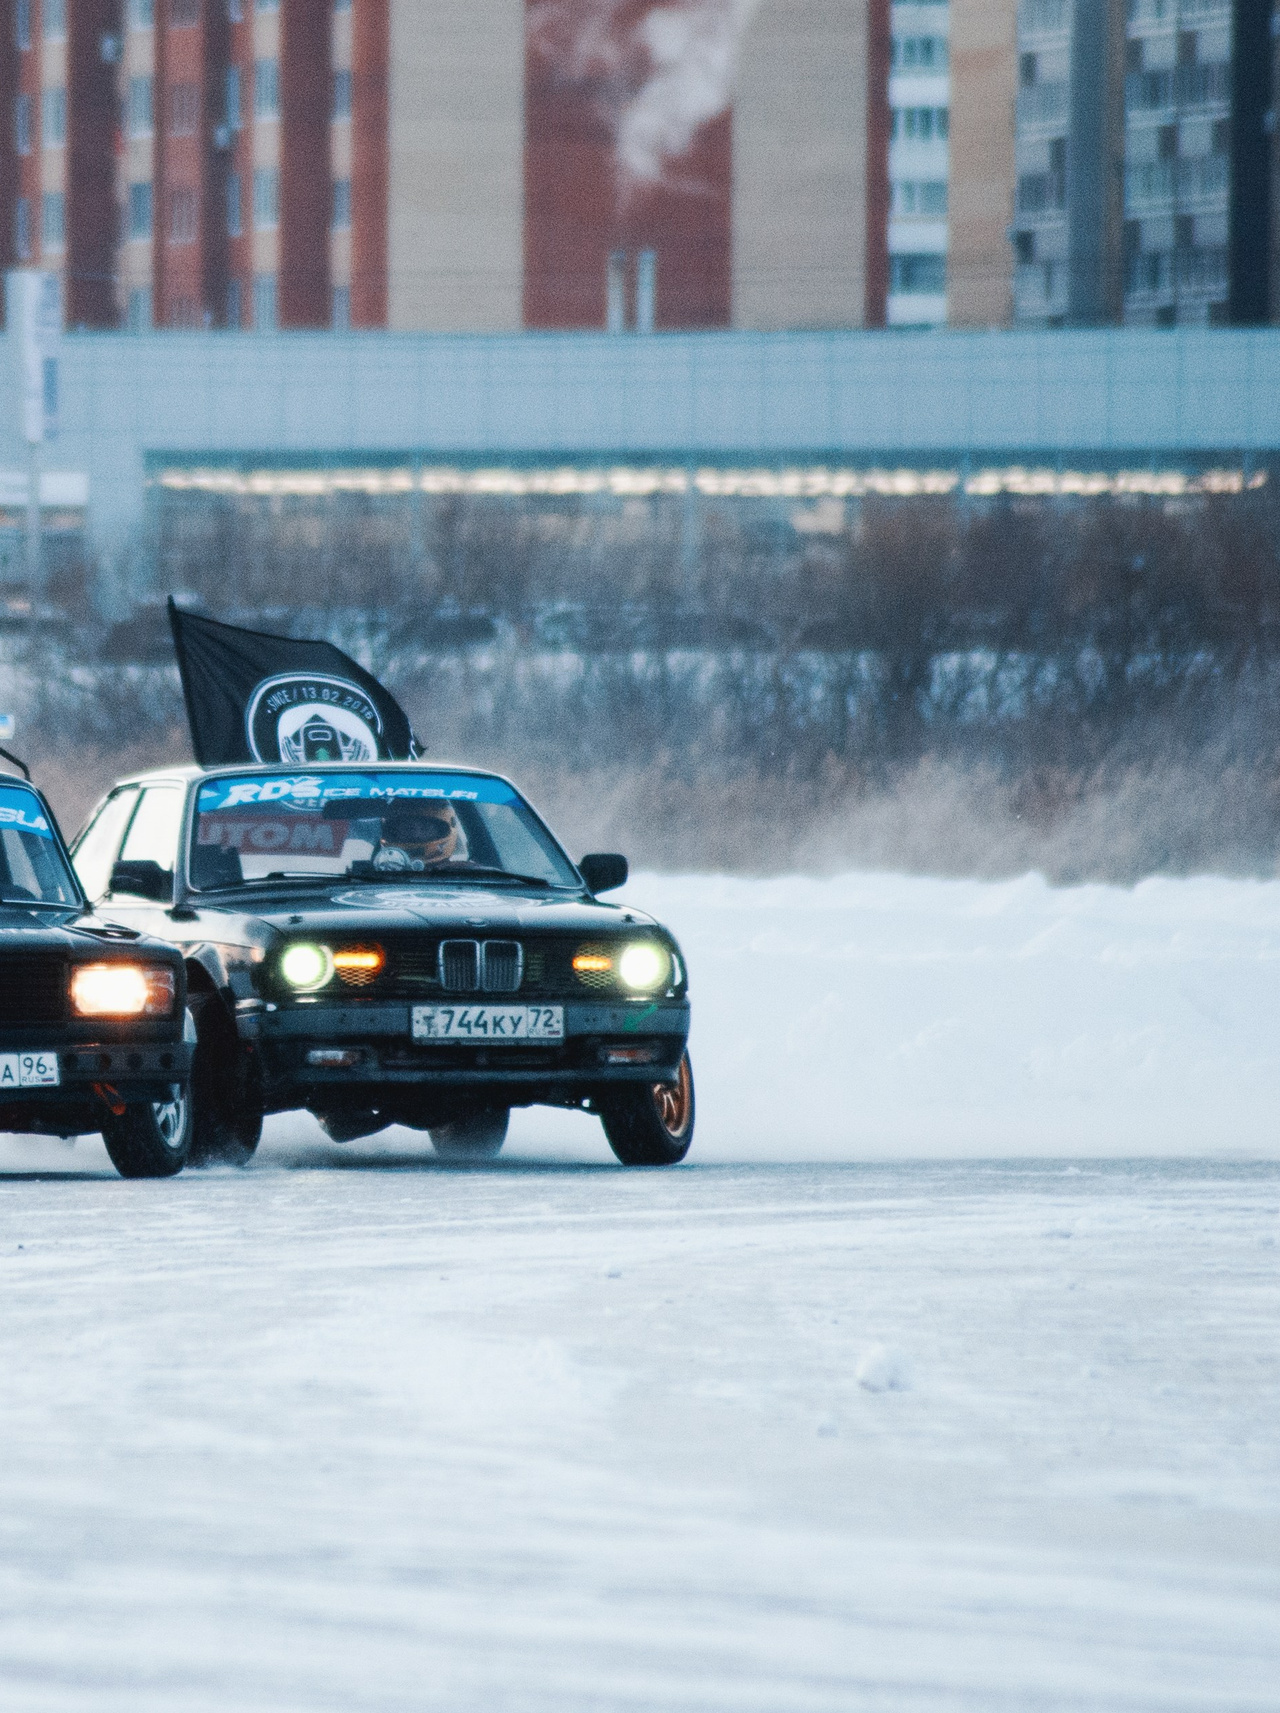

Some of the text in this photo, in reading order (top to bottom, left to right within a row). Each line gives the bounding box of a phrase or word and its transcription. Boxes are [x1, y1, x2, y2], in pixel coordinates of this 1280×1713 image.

[217, 776, 323, 808] RDS
[530, 1008, 554, 1028] 72
[23, 1056, 47, 1075] 96
[21, 1076, 41, 1084] RUS
